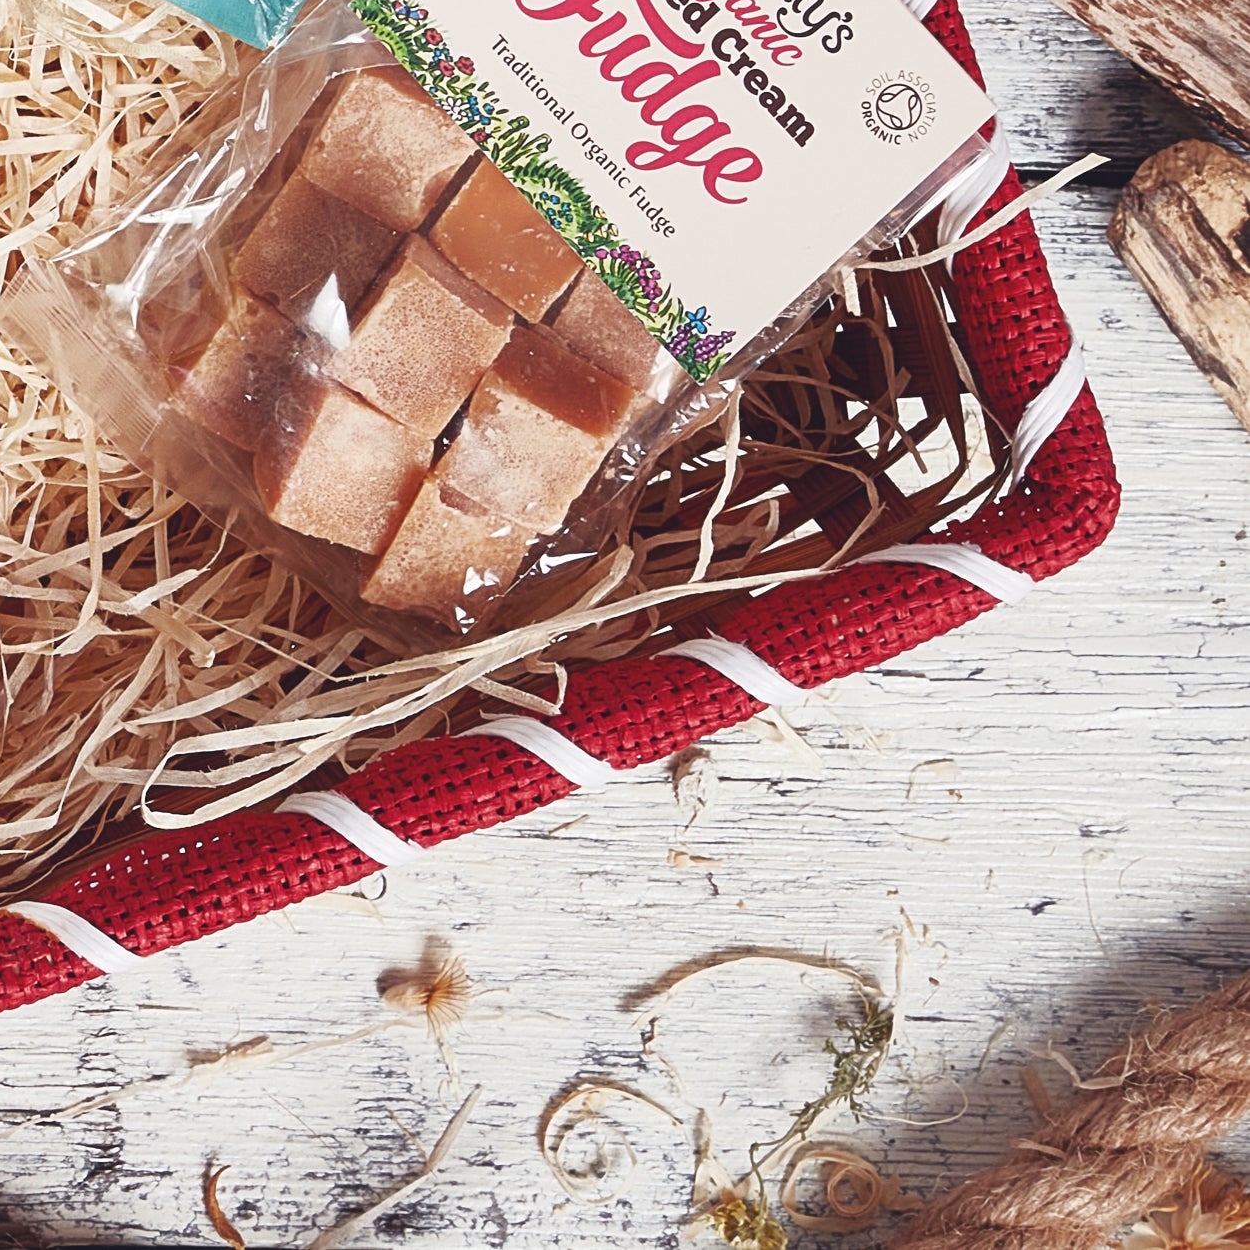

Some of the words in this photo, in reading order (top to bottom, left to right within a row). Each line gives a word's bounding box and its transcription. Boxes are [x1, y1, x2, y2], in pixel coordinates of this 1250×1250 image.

[492, 34, 574, 125] Traditional
[571, 123, 631, 189] Organic
[629, 186, 675, 238] Fudge
[710, 28, 817, 148] Cream
[861, 101, 901, 145] ORGANIC
[865, 72, 893, 96] SOIL
[898, 70, 936, 142] ASSOCIATION
